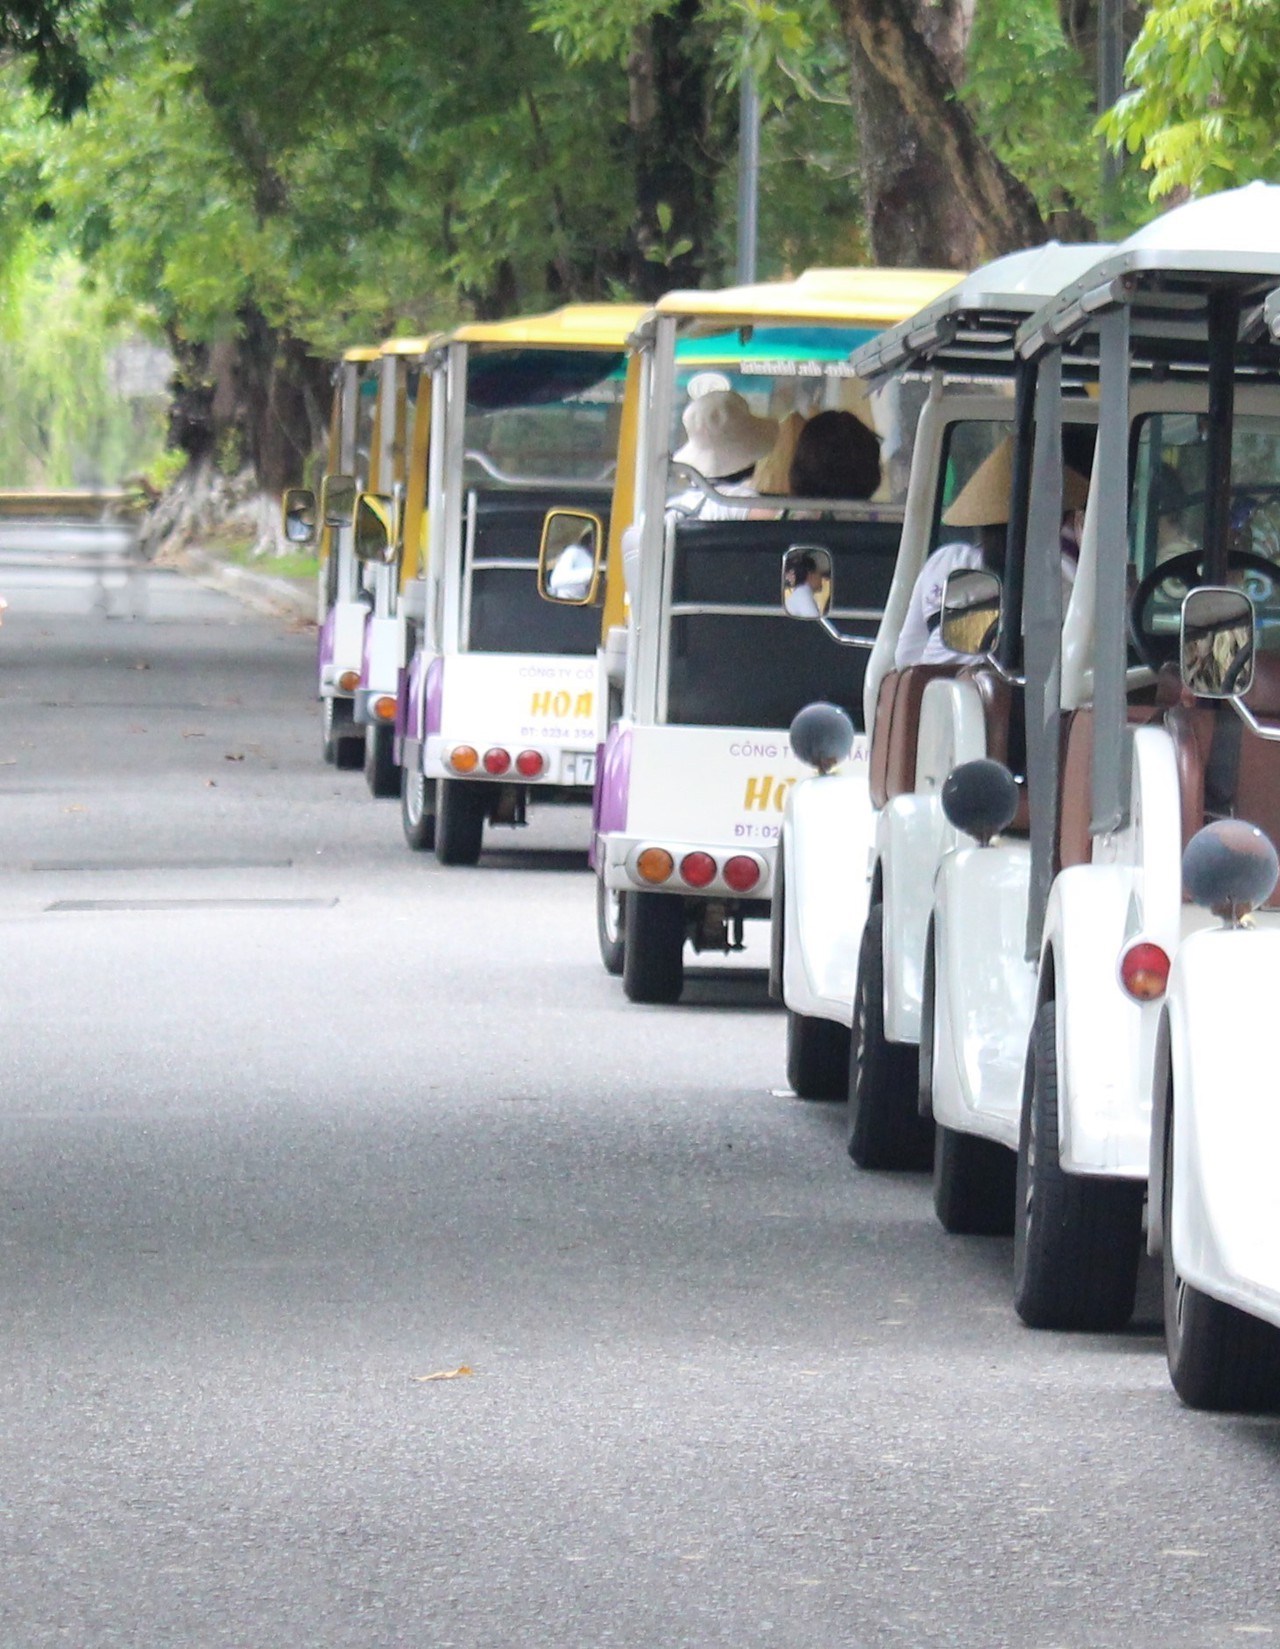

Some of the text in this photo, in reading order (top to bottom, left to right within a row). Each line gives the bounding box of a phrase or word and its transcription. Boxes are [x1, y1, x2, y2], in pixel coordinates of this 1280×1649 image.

[558, 668, 572, 678] TY
[531, 690, 593, 718] HOA
[730, 741, 778, 758] CÔNG
